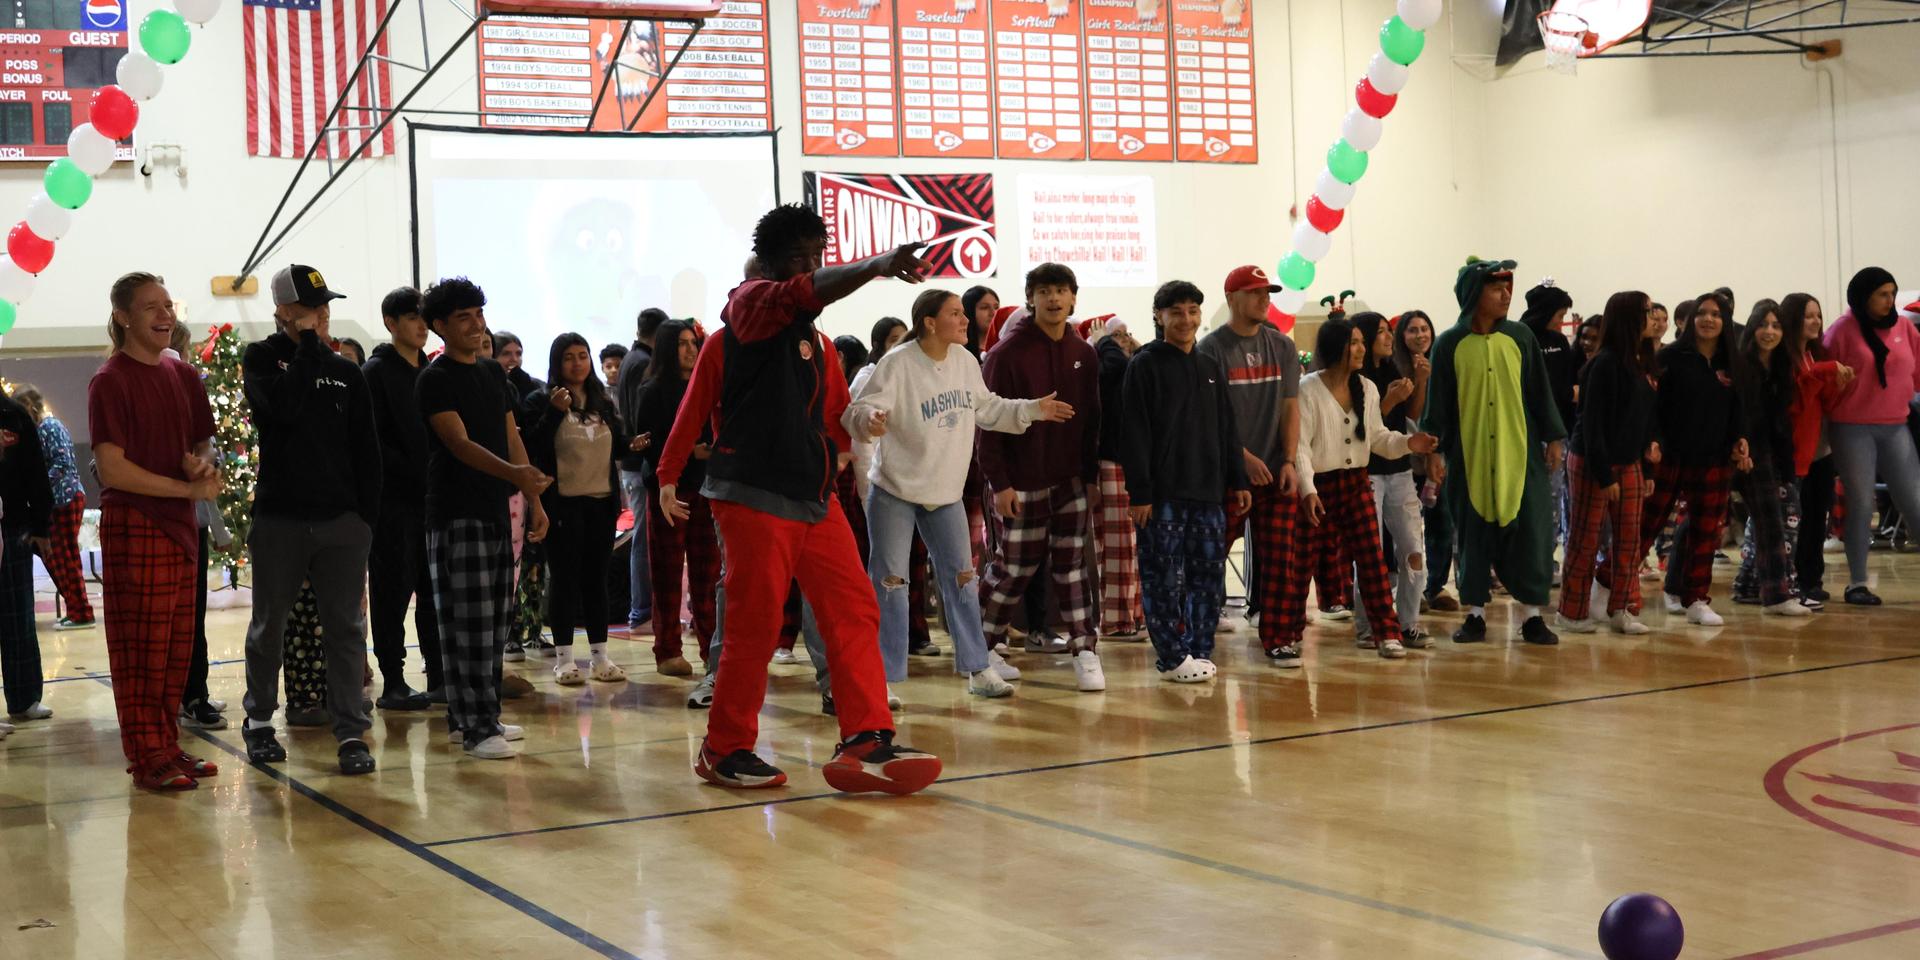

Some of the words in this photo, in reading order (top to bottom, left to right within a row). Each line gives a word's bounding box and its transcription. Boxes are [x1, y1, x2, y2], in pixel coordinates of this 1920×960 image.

[818, 6, 870, 18] Football
[1011, 16, 1056, 28] Softball
[1114, 20, 1164, 32] Basketball
[1200, 26, 1249, 38] Basketball
[0, 34, 41, 43] PERIOD
[70, 32, 119, 45] GUEST
[699, 37, 725, 45] GIRLS
[728, 37, 752, 46] GOLF
[523, 47, 573, 56] BASEBALL
[705, 53, 756, 62] BASEBALL
[6, 60, 38, 70] POSS
[545, 65, 583, 74] SOCCER
[3, 74, 42, 83] BONUS
[704, 70, 749, 79] FOOTBALL
[42, 91, 72, 100] FOUL
[701, 119, 764, 127] FOOTBALL
[824, 188, 838, 262] REDSKINS
[838, 188, 937, 263] ONWARD
[921, 390, 973, 422] NASHVILLE
